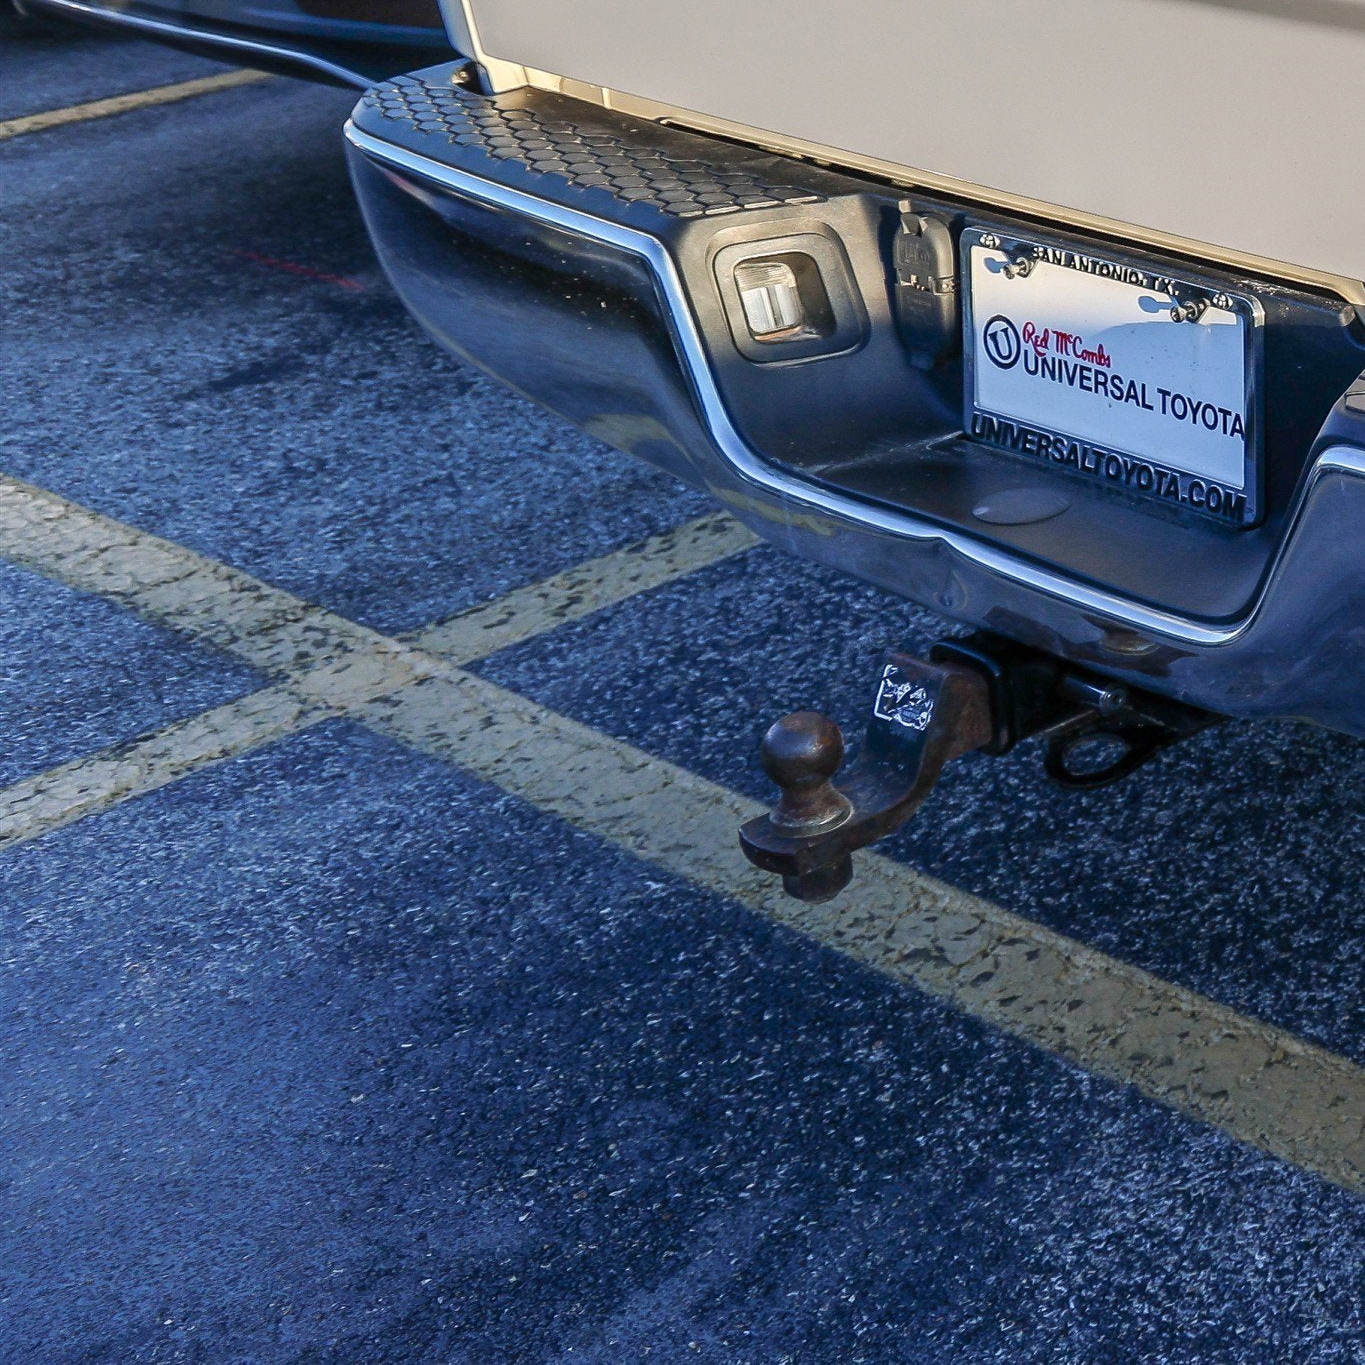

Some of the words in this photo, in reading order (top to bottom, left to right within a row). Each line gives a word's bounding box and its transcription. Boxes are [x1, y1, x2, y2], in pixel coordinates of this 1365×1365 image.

[1032, 246, 1066, 266] SAN
[1022, 321, 1050, 358] Red
[1051, 328, 1111, 369] McCombs
[1023, 349, 1155, 412] UNIVERSAL
[1156, 387, 1246, 443] TOYOTA
[970, 411, 1248, 522] UNIVERSALTOYOTA.COM
